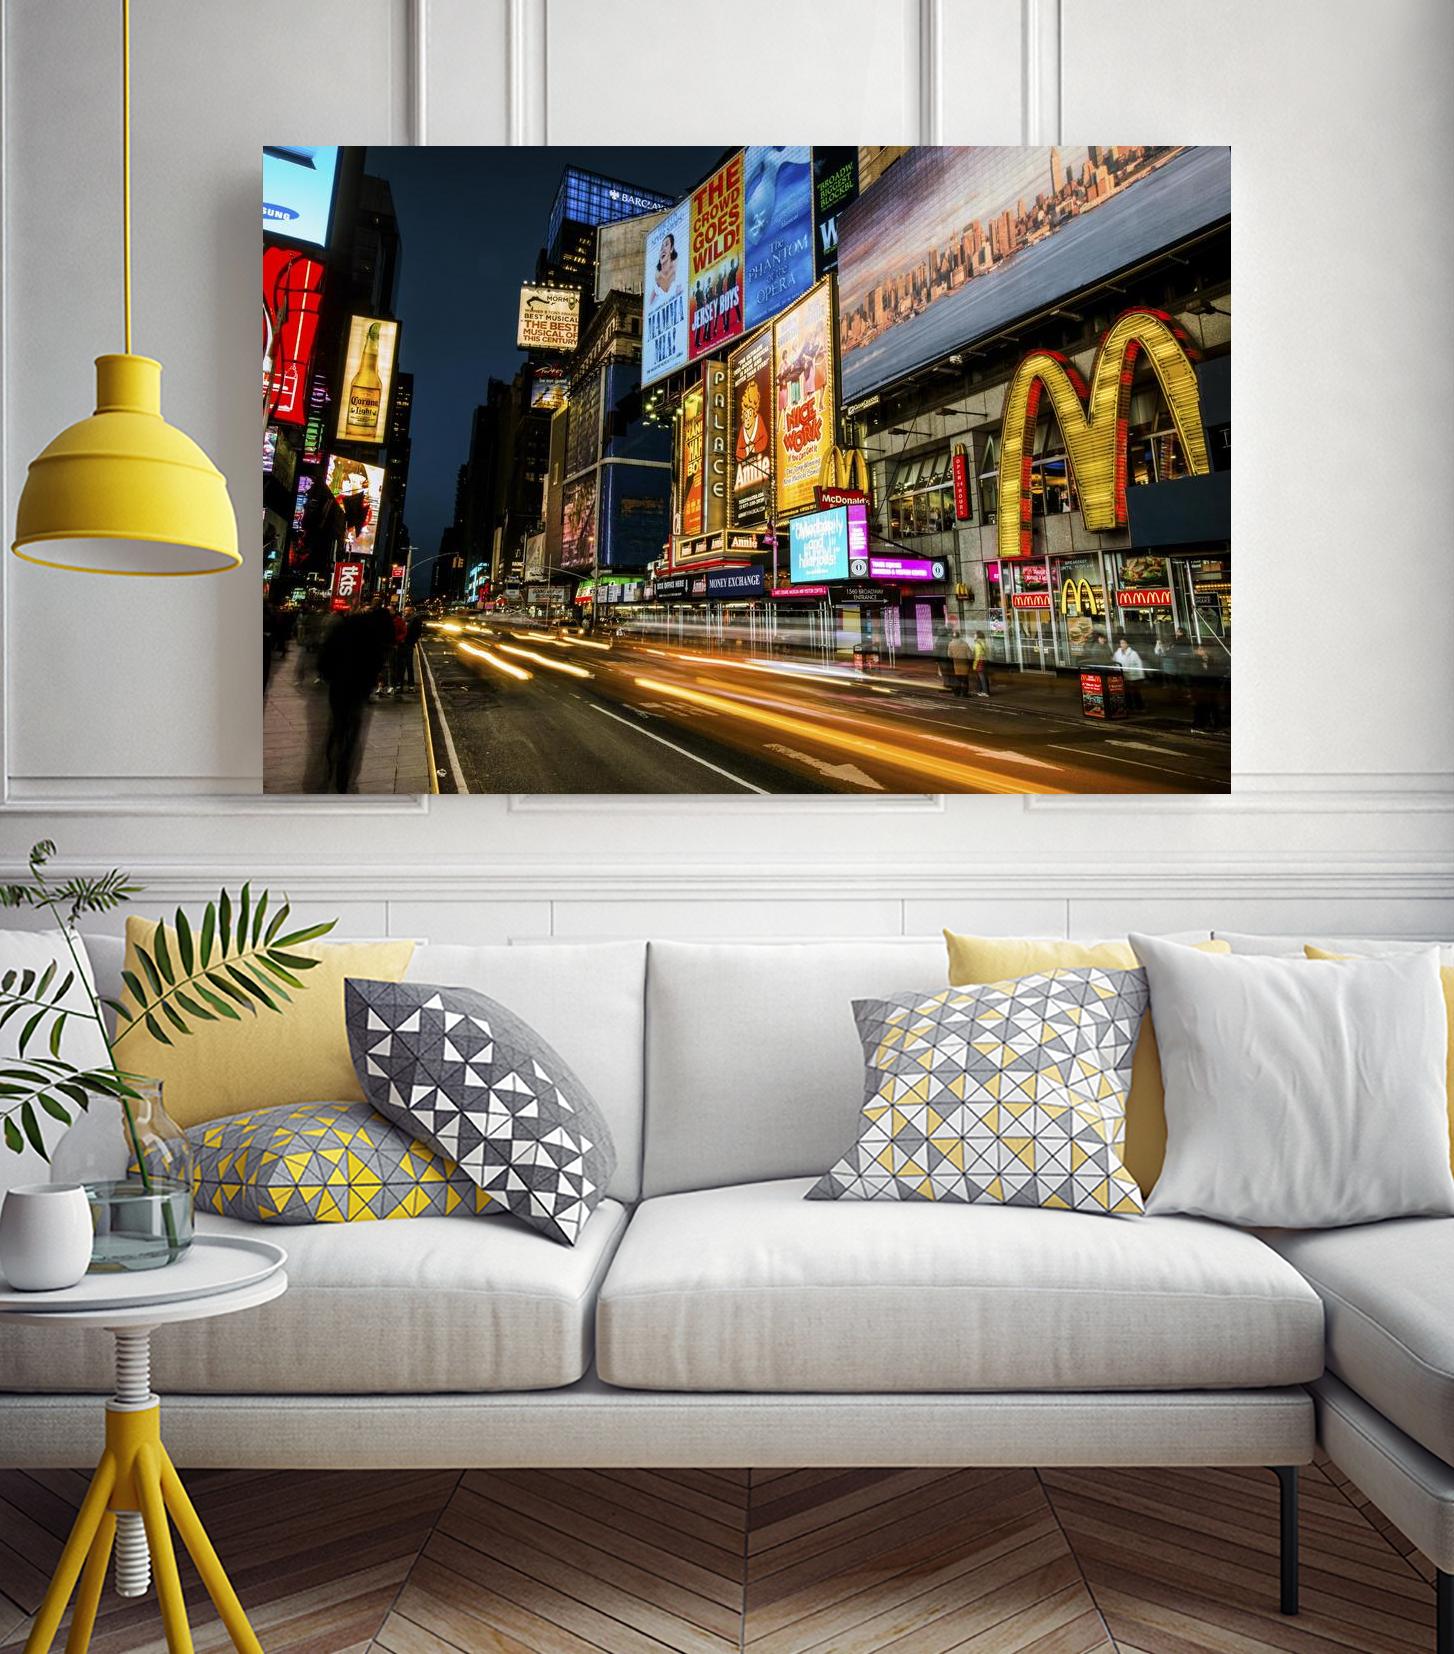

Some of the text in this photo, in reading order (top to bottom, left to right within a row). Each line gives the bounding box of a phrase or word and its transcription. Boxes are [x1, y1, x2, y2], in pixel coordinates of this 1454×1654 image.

[693, 156, 740, 214] THE
[820, 172, 851, 199] BIGGEST
[693, 187, 740, 233] CROWD
[693, 203, 739, 253] GOES
[693, 223, 740, 274] WILD!
[748, 234, 808, 282] PHANTOM
[547, 295, 580, 303] MORMON
[756, 272, 796, 304] OPERA
[546, 315, 578, 323] MUSICAL
[692, 297, 718, 332] JERSEY
[719, 286, 739, 314] BOYS
[523, 328, 564, 338] MUSICAL
[542, 337, 577, 345] CENTURY
[550, 322, 578, 332] BEST
[786, 396, 816, 432] NICE
[713, 371, 726, 497] PALACE
[783, 418, 822, 452] WORK
[734, 453, 770, 490] Annie
[822, 494, 869, 507] McDonald's
[732, 534, 757, 549] Annie
[339, 565, 358, 596] tkts
[709, 574, 760, 589] MONEY EXCHANGE
